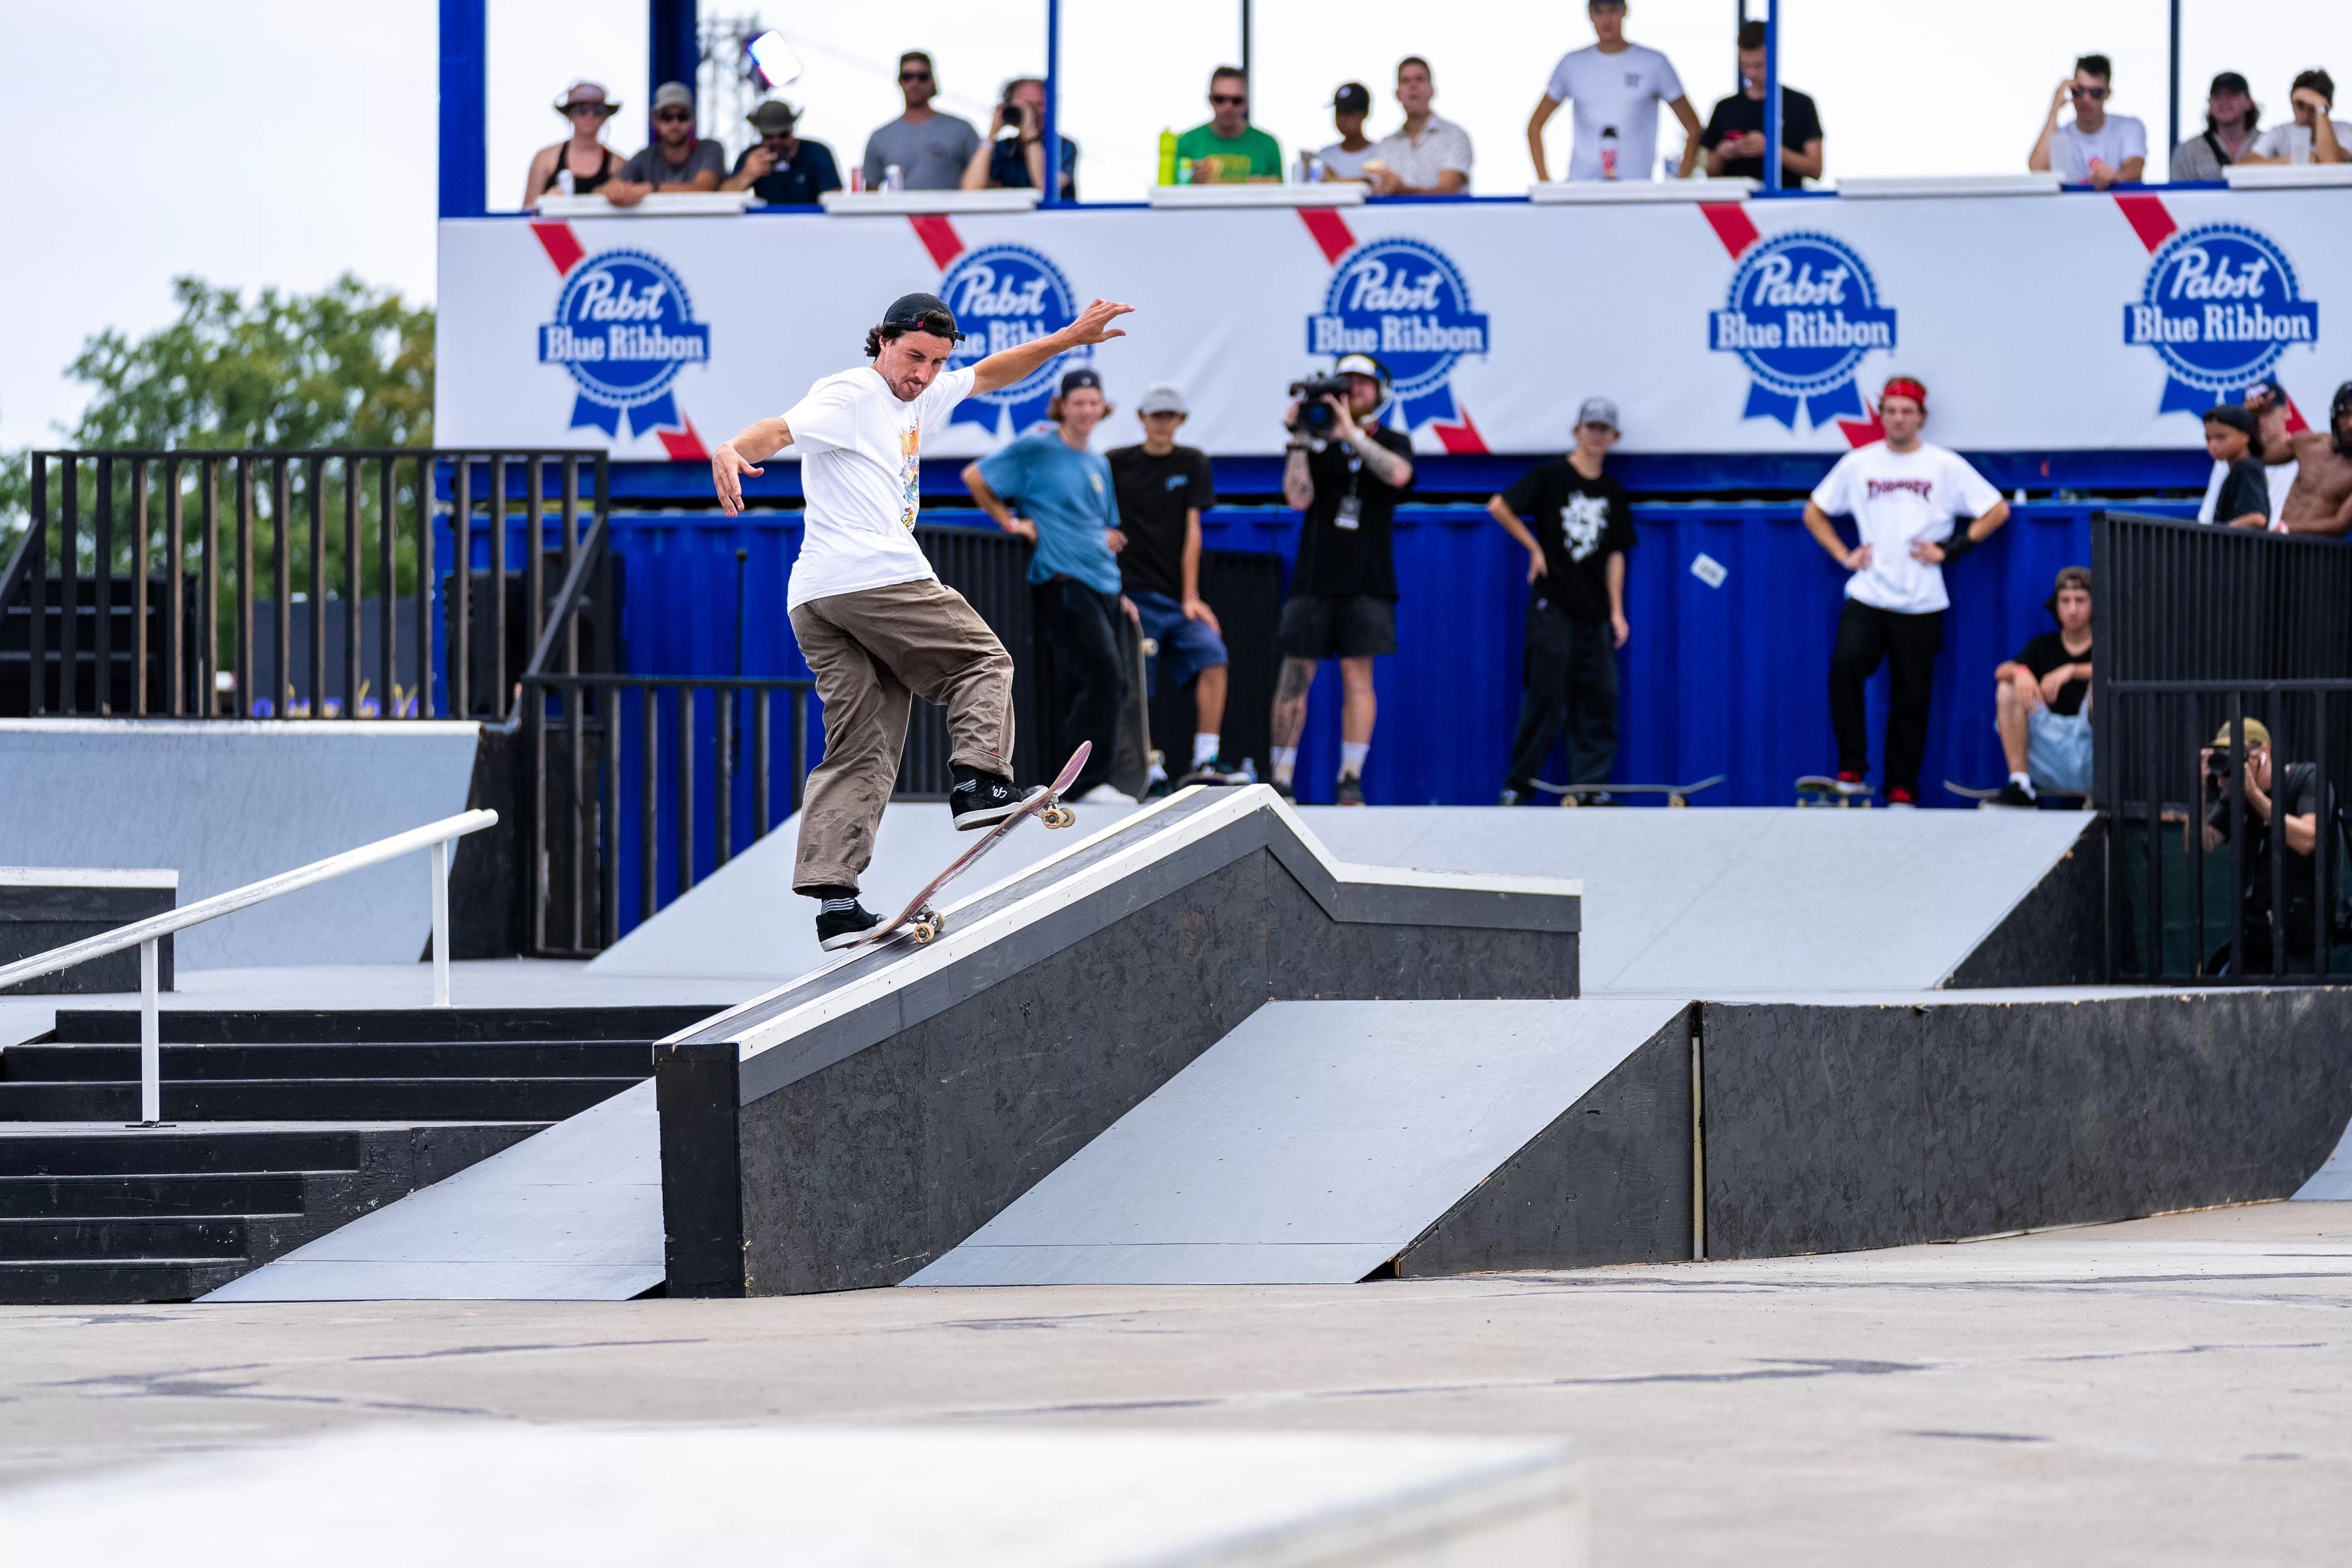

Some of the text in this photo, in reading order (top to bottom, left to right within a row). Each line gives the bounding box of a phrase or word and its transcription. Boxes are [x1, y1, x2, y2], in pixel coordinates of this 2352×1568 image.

[576, 270, 667, 322] Pabst
[957, 266, 1049, 317] Pabst
[1349, 260, 1442, 311] Pabst
[1753, 254, 1850, 306] Pabst
[2169, 246, 2269, 300] Pabst
[546, 324, 703, 361] Blue Ribbon
[1315, 315, 1483, 352] Blue Ribbon
[1717, 309, 1891, 349] Blue Ribbon
[2132, 303, 2311, 343] Blue Ribbon
